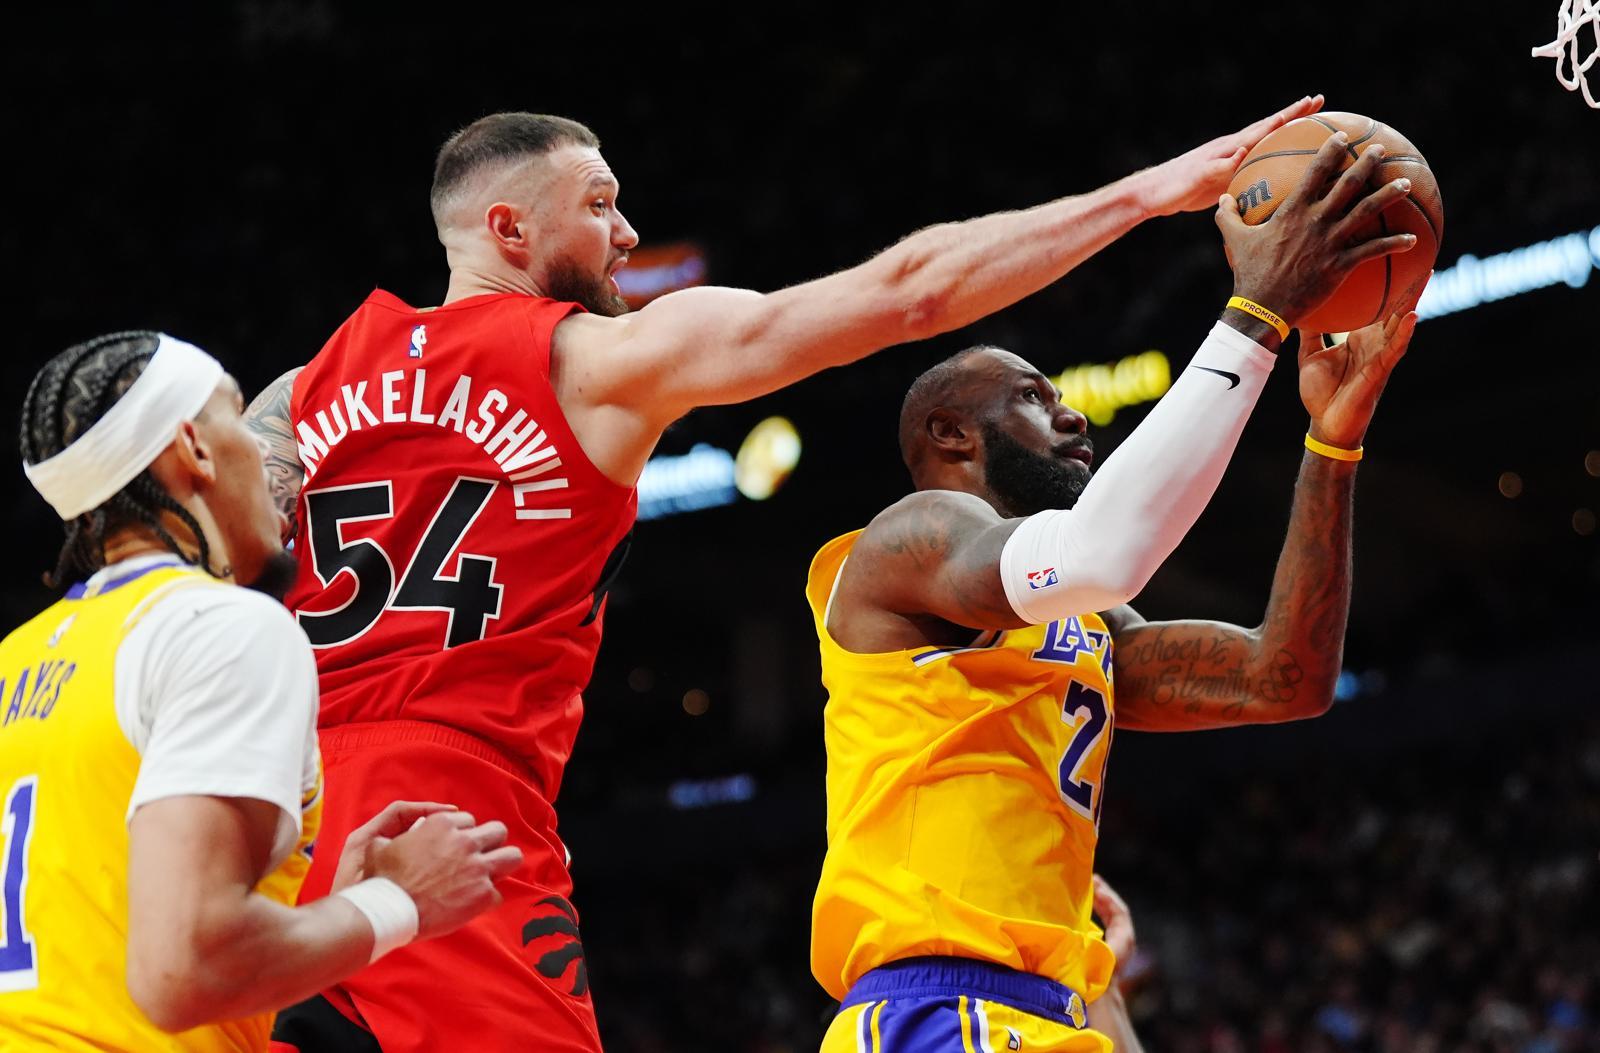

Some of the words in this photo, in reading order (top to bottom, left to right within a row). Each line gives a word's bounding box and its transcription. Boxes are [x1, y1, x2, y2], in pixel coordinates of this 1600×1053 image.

[1244, 302, 1280, 326] PROMISE
[296, 368, 572, 520] MUKELASHVILI
[295, 475, 505, 651] 54
[0, 659, 76, 727] AYES
[1058, 679, 1112, 823] 2
